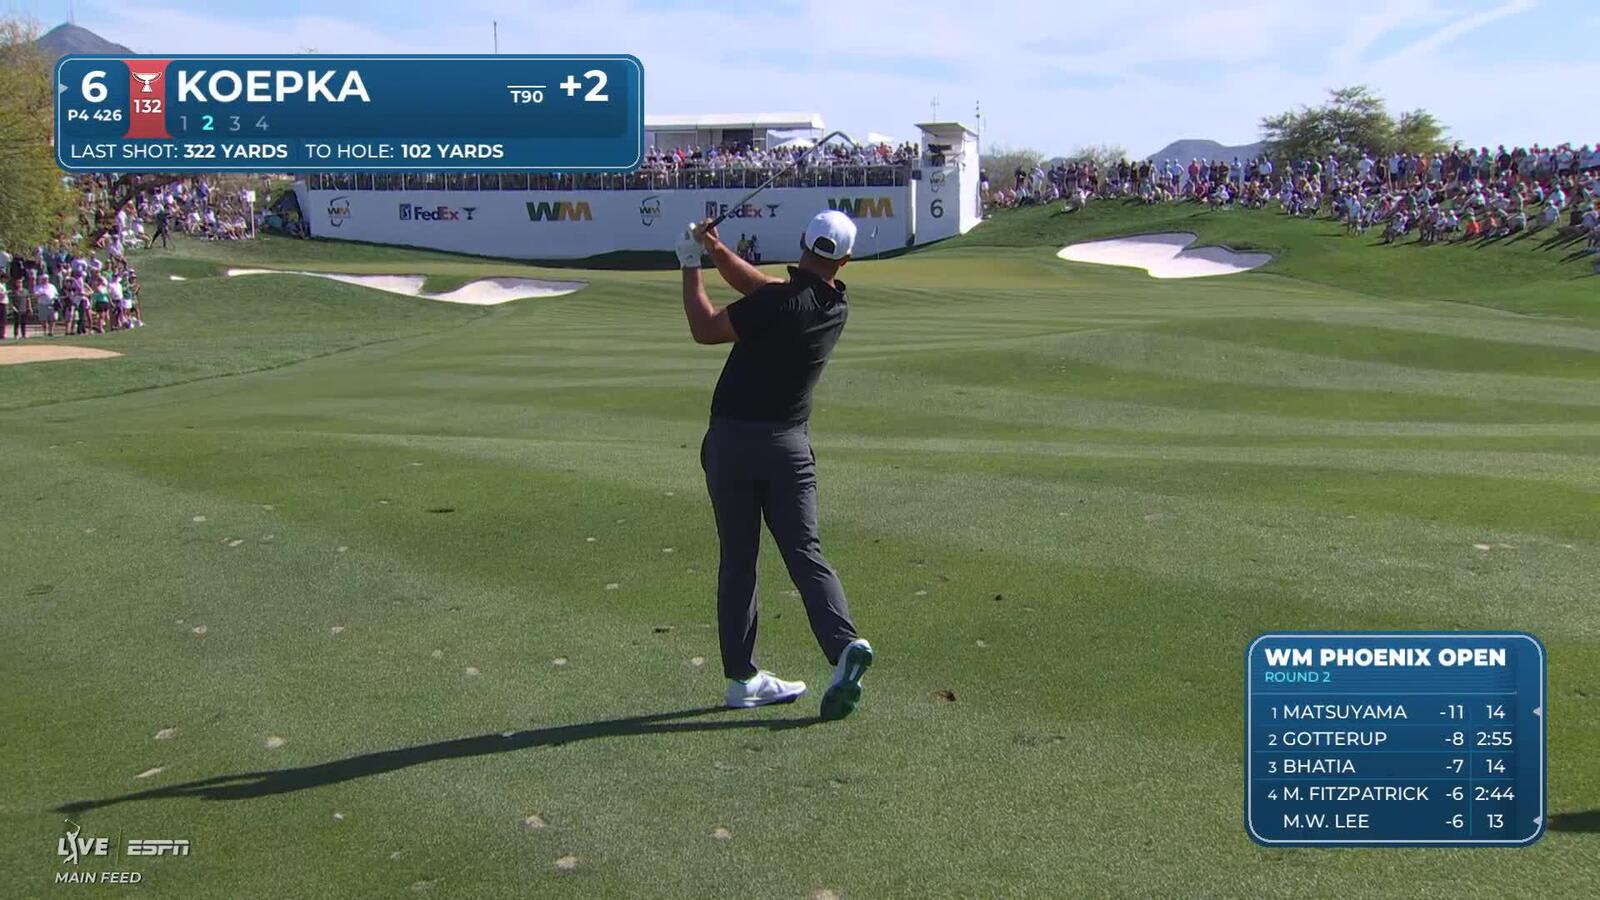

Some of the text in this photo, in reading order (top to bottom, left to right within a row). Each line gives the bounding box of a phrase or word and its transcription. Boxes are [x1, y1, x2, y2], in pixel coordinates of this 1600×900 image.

[414, 206, 459, 221] FedEx
[526, 201, 592, 221] WM
[827, 197, 893, 218] WM
[930, 199, 943, 218] 6
